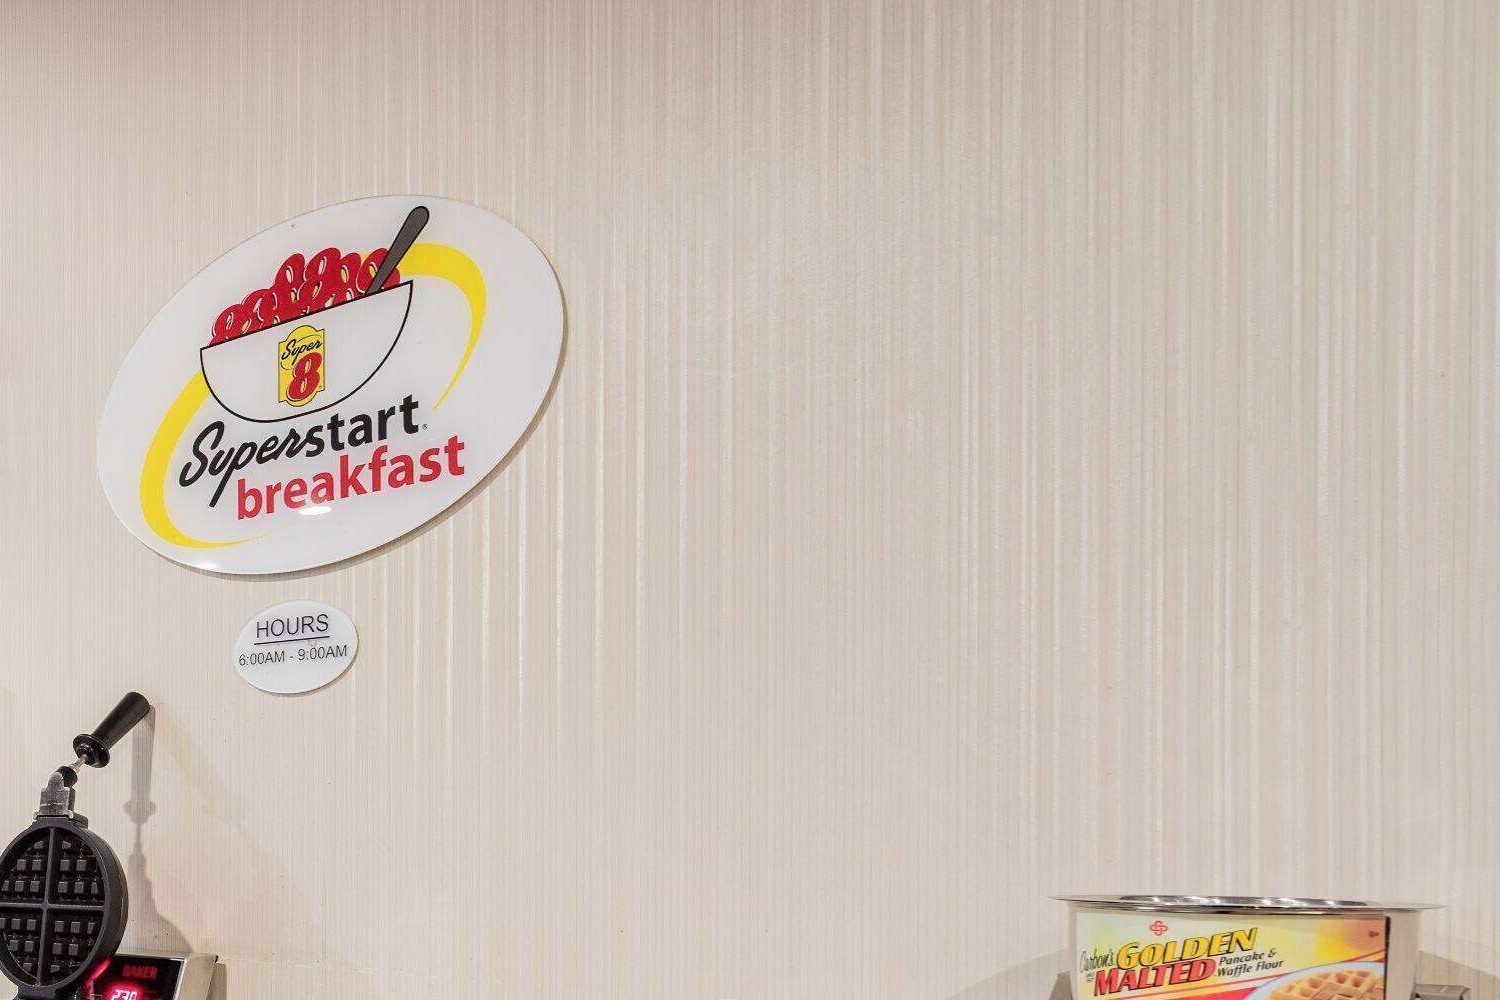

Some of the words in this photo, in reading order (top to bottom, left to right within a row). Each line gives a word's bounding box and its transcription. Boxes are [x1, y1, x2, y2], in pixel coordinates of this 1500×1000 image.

[281, 337, 323, 362] Super
[286, 352, 323, 402] 8
[179, 394, 420, 508] Superstart
[236, 435, 466, 521] breakfast
[256, 613, 329, 639] HOURS
[238, 649, 286, 667] 6:00AM
[297, 644, 348, 661] 9:00AM
[1116, 926, 1258, 971] GOLDEN
[1219, 950, 1266, 967] Pancake
[1268, 947, 1277, 958] &
[1093, 958, 1217, 997] MALTED
[1218, 963, 1253, 978] Waffle
[1256, 960, 1285, 972] Flour
